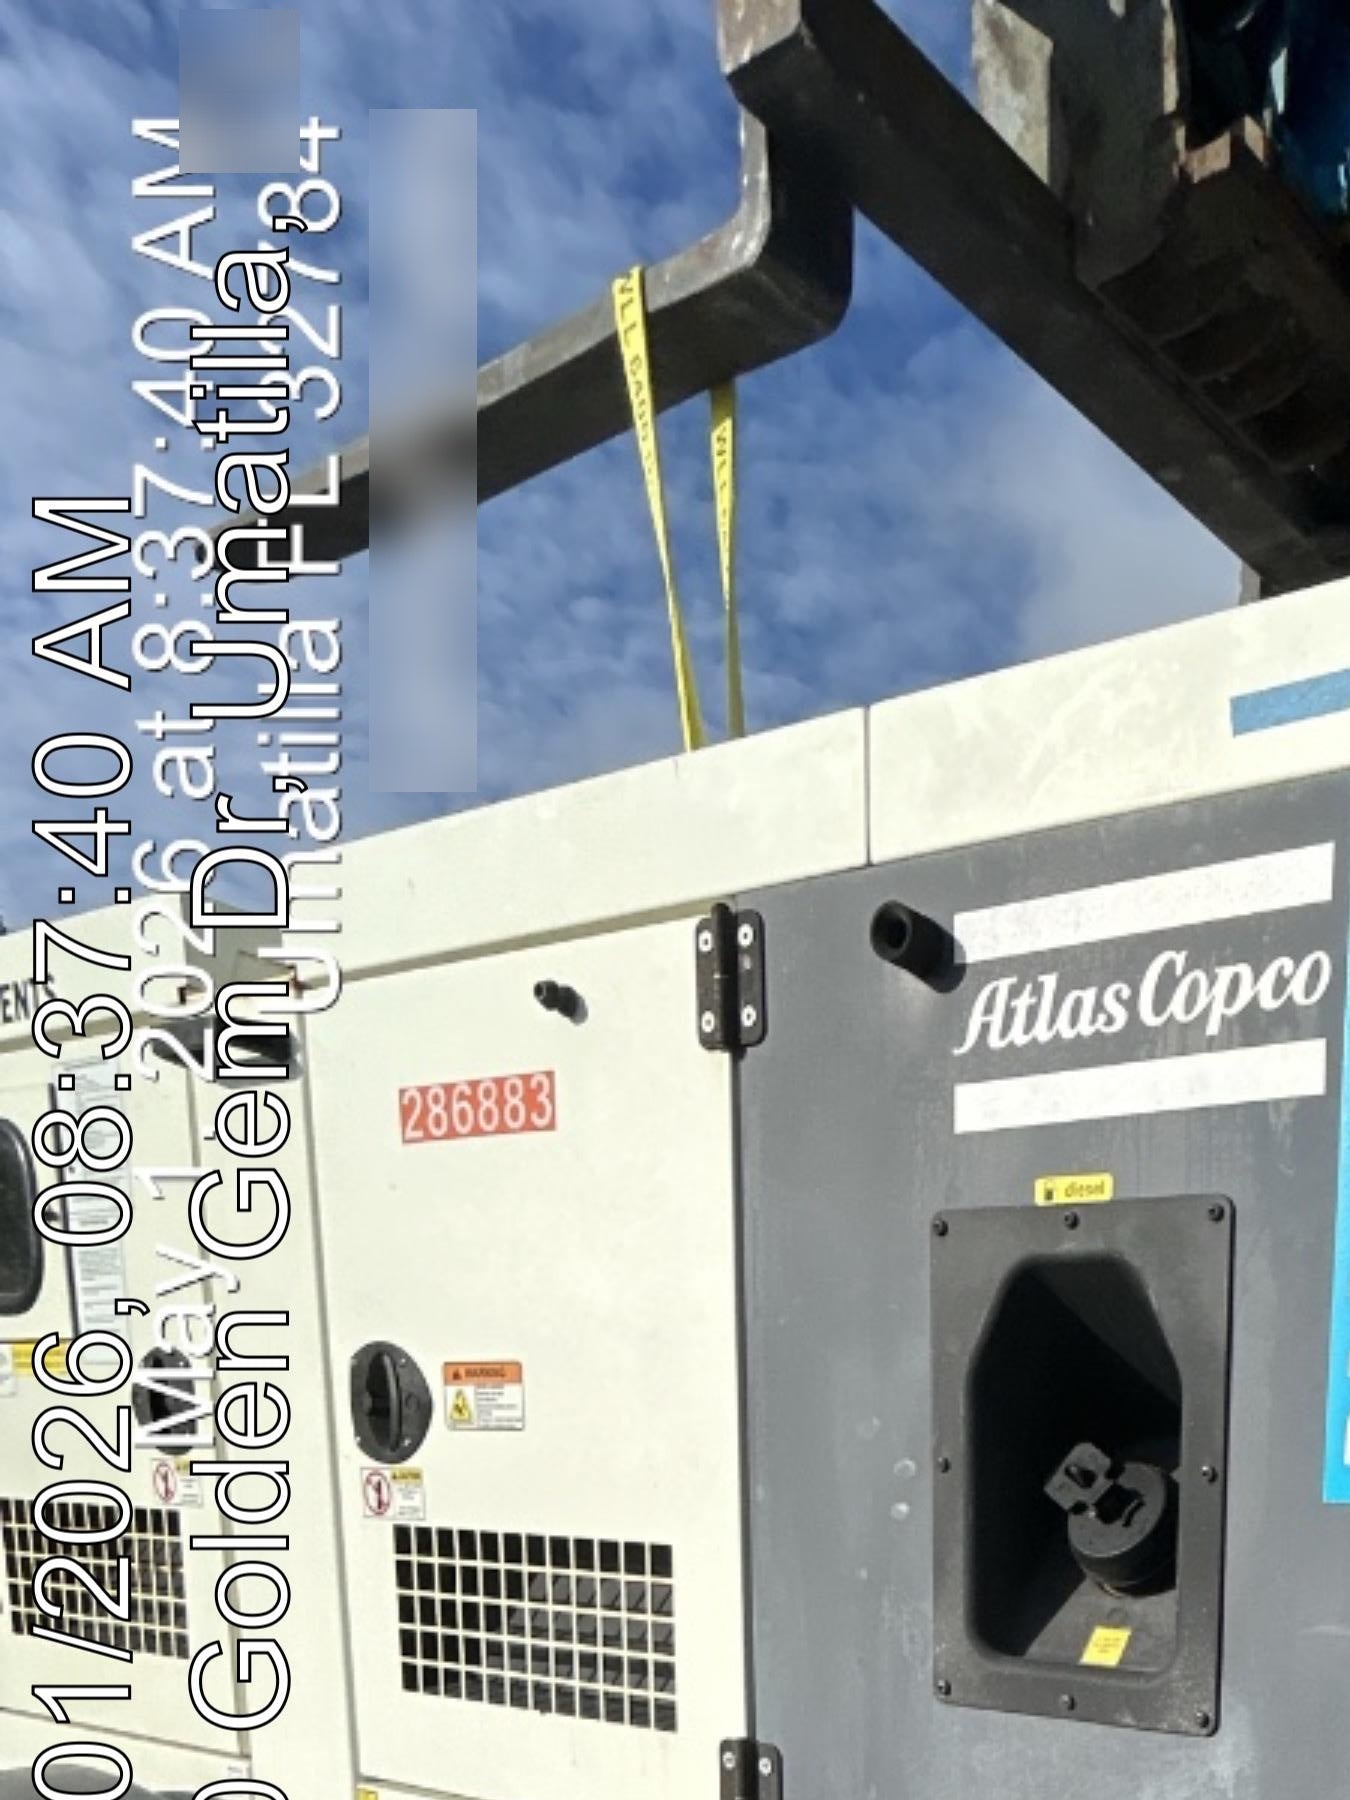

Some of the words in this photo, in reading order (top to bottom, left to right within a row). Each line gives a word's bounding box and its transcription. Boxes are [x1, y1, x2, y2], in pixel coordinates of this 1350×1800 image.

[952, 971, 1132, 1056] Atlas
[1137, 949, 1332, 1037] Copco
[401, 1072, 553, 1139] 286883
